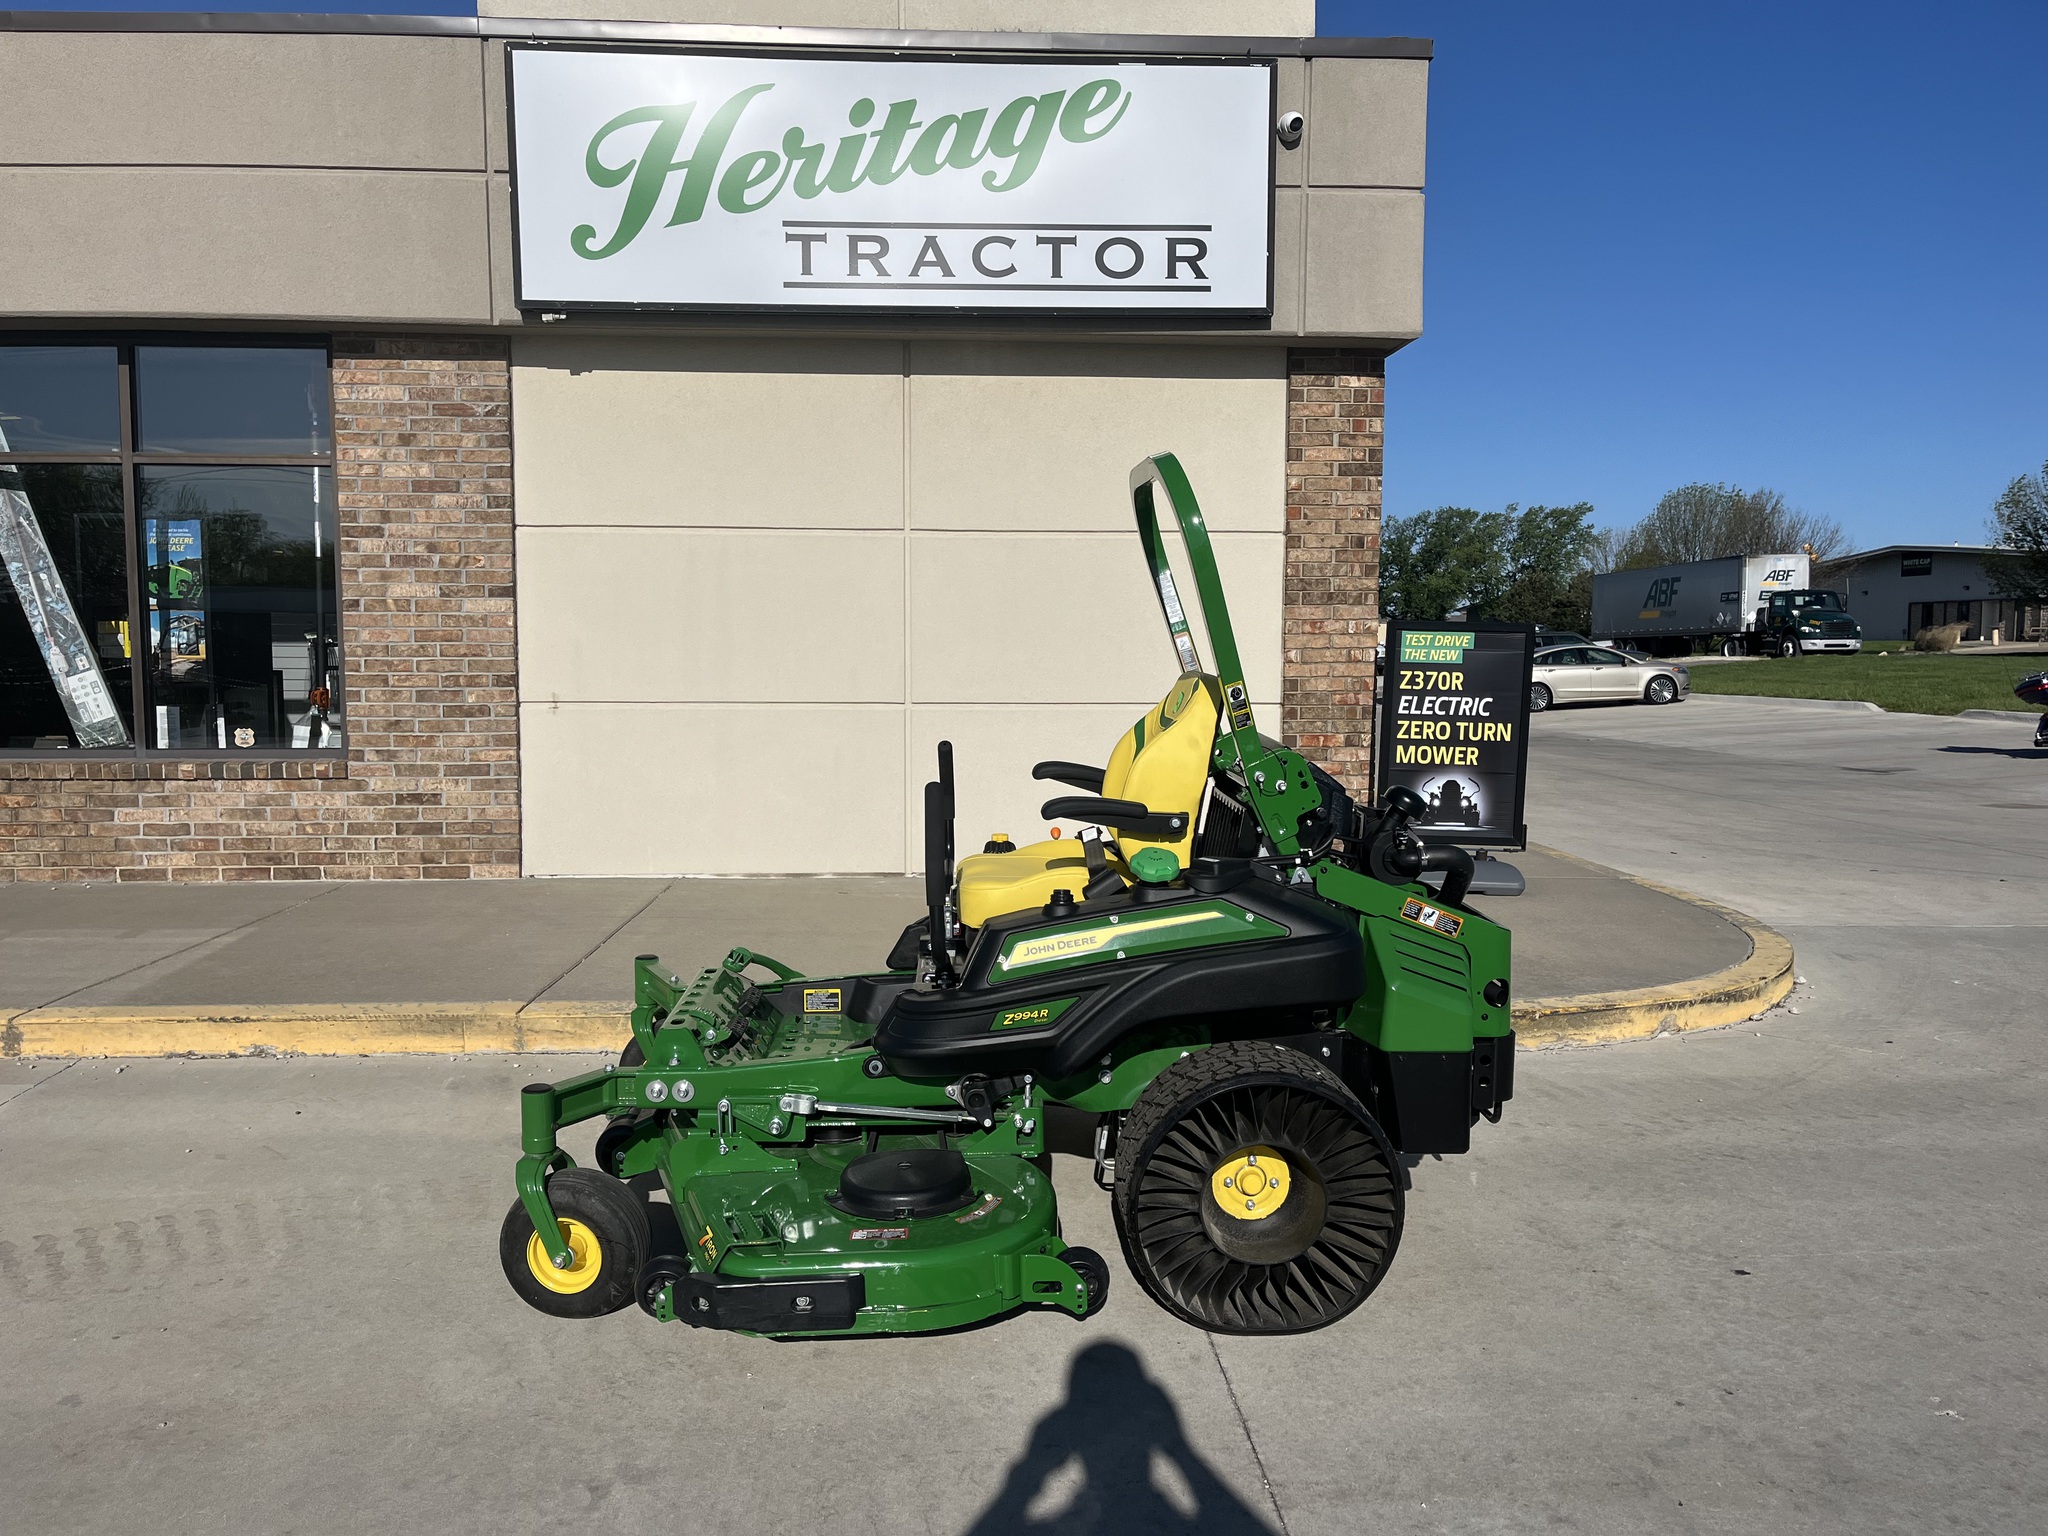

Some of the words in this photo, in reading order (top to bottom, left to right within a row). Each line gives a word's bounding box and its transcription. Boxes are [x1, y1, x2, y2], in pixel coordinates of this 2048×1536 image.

[570, 79, 1132, 261] Heritage
[784, 231, 1211, 280] TRACTOR
[1763, 569, 1796, 582] ABF
[1642, 576, 1682, 609] ABF
[1405, 634, 1434, 646] TEST
[1435, 635, 1470, 647] DRIVE
[1404, 648, 1429, 660] THE
[1430, 649, 1459, 661] NEW
[1399, 670, 1464, 691] Z370R
[1397, 695, 1494, 717] ELECTRIC
[1396, 720, 1451, 741] ZERO
[1455, 722, 1513, 742] TURN
[1395, 745, 1479, 766] MOWER
[1023, 944, 1055, 956] JOHN
[1057, 936, 1097, 949] DEERE
[1003, 1009, 1049, 1025] Z994R
